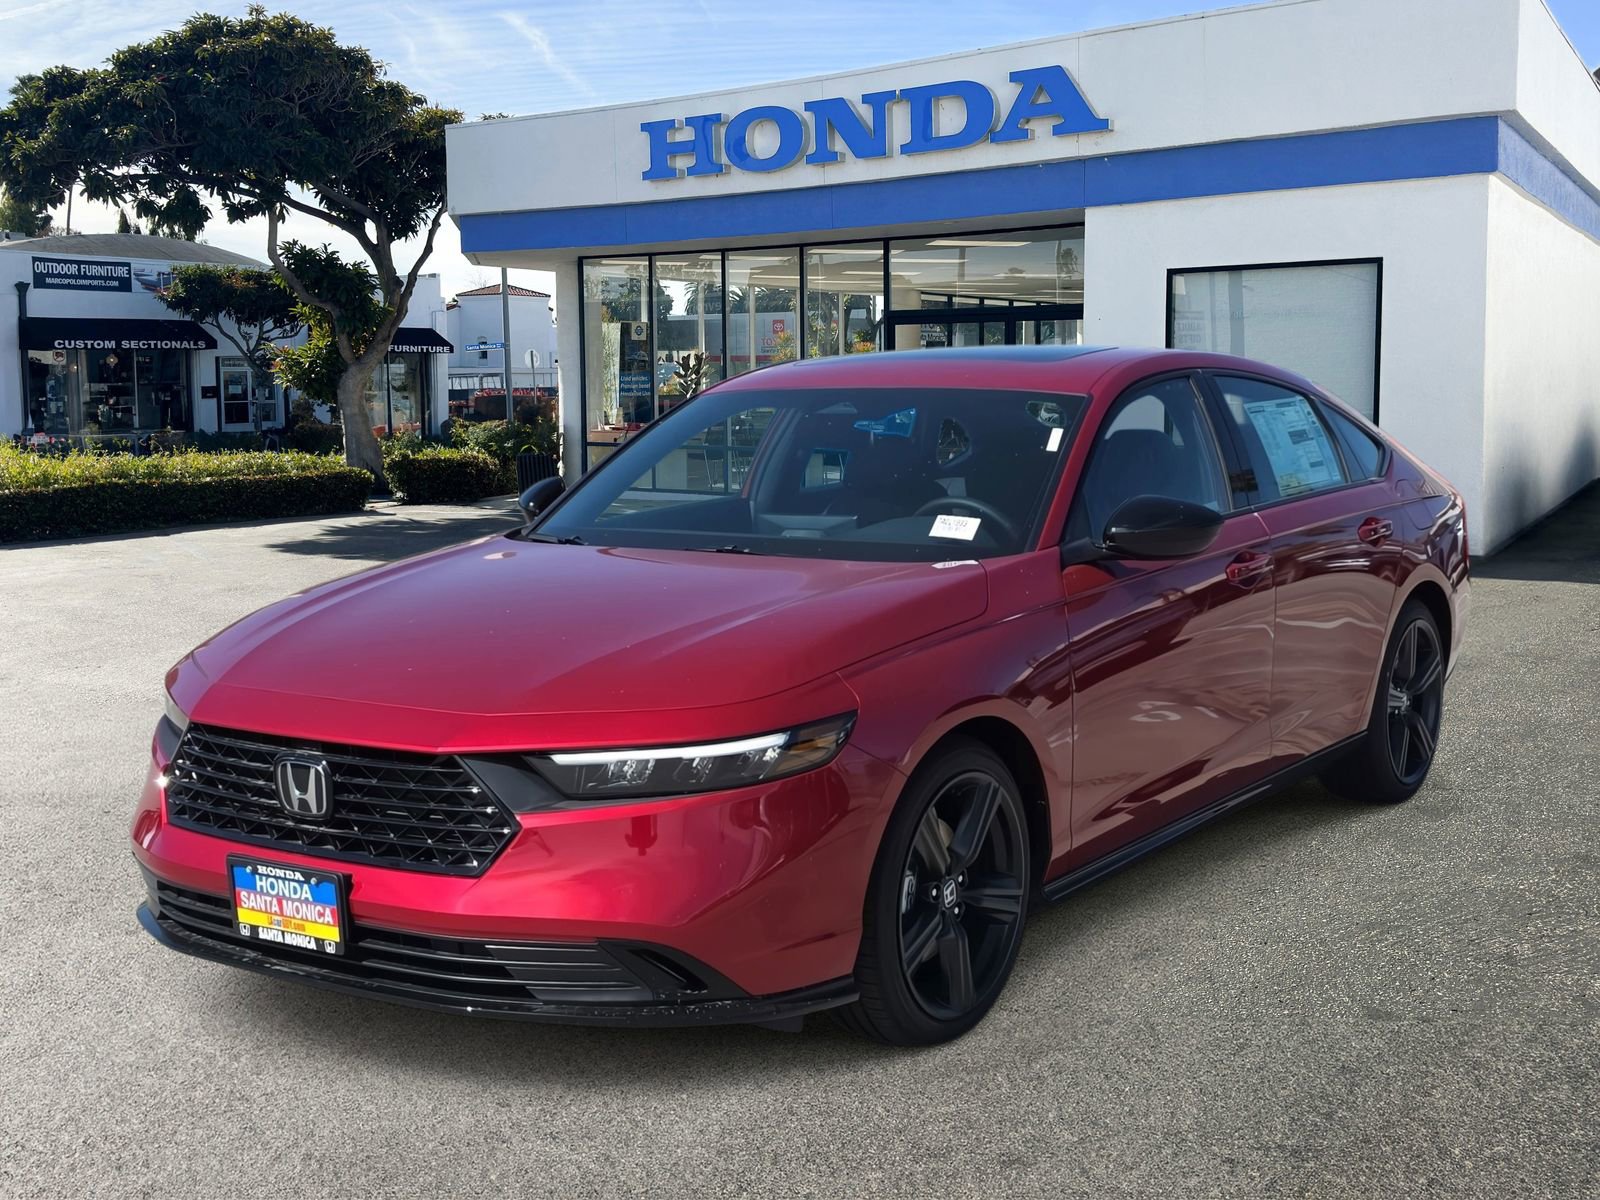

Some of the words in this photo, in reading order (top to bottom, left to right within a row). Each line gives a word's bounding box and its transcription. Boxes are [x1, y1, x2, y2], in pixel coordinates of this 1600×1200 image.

[640, 65, 1110, 181] HONDA
[34, 261, 79, 277] OUTDOOR
[80, 264, 130, 278] FURNITURE
[45, 277, 120, 288] MARCOPOLOIMPORTS.COM
[54, 339, 117, 350] CUSTOM
[120, 339, 207, 349] SECTIONALS
[387, 344, 451, 354] FURNITURE
[256, 865, 305, 881] HONDA
[255, 874, 313, 902] HONDA
[240, 891, 280, 915] SANTA
[281, 898, 333, 925] MONICA
[258, 926, 284, 943] SANTA
[284, 931, 317, 951] MONICA
